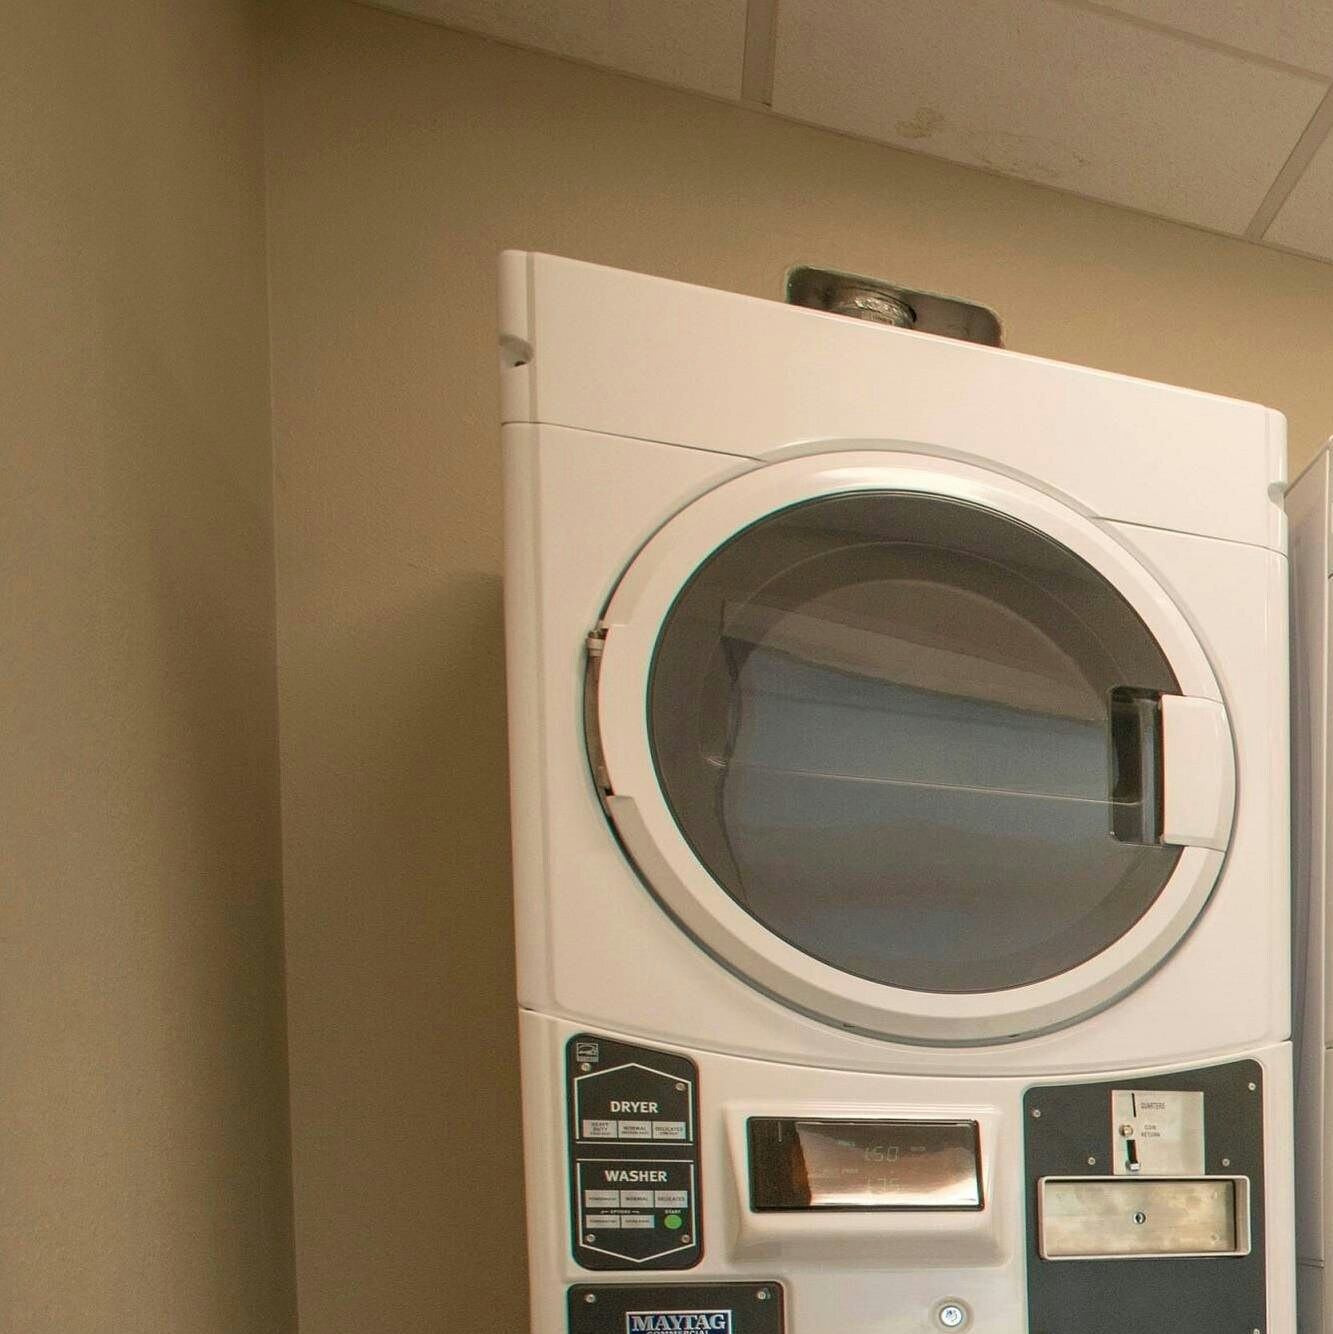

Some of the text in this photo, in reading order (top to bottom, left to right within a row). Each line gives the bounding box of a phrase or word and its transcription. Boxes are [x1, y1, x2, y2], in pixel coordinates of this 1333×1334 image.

[610, 1100, 659, 1114] DRYER
[604, 1170, 668, 1182] WASHER
[631, 1314, 727, 1332] MAYTAG
